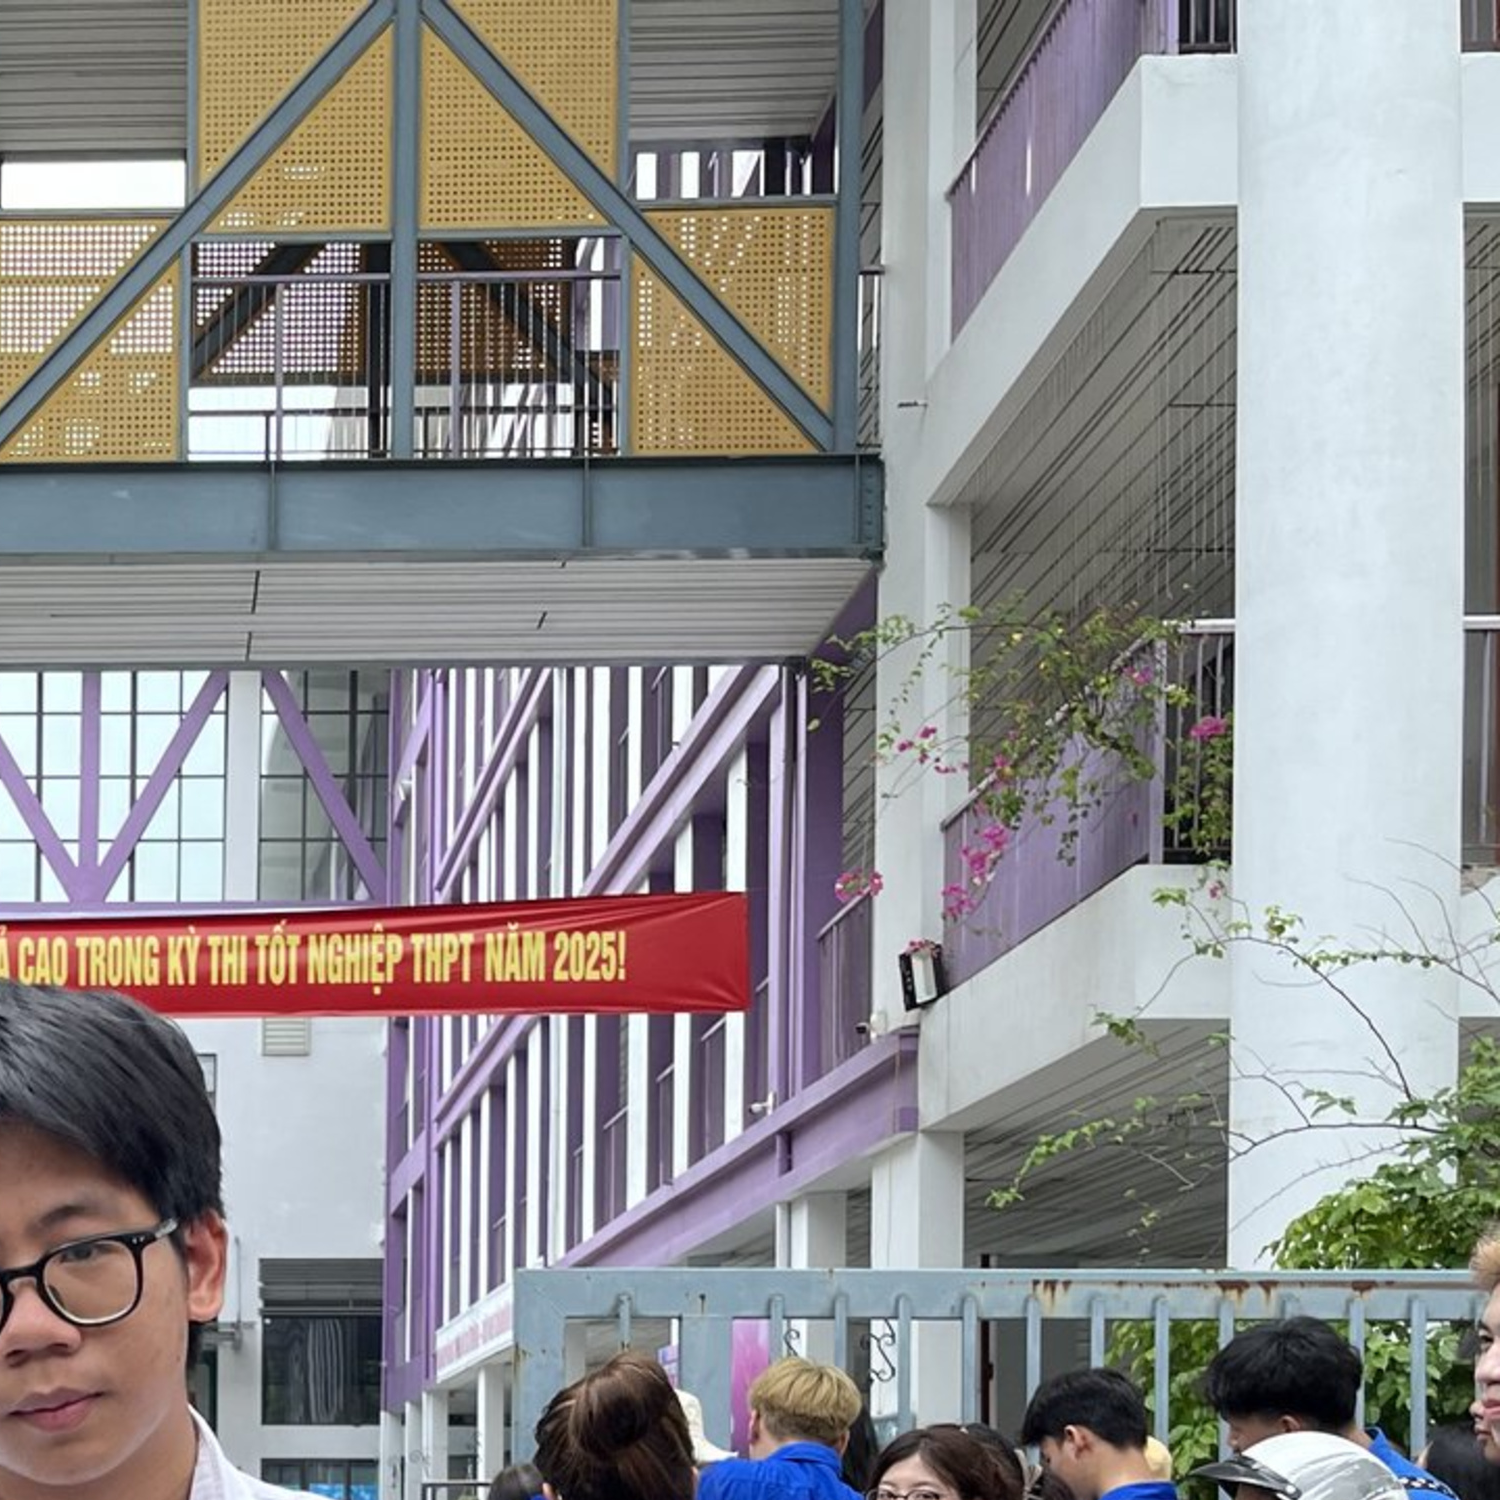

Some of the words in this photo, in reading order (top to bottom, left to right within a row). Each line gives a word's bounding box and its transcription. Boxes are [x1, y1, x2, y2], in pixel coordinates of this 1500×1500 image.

[18, 936, 68, 986] CAO
[75, 935, 160, 986] TRONG
[167, 925, 200, 986] KỲ
[207, 935, 247, 985] THI
[255, 919, 301, 985] TỐT
[307, 922, 404, 995] NGHIỆP
[410, 932, 475, 983] THPT
[485, 922, 546, 982] NĂM
[552, 930, 627, 981] 2025!
